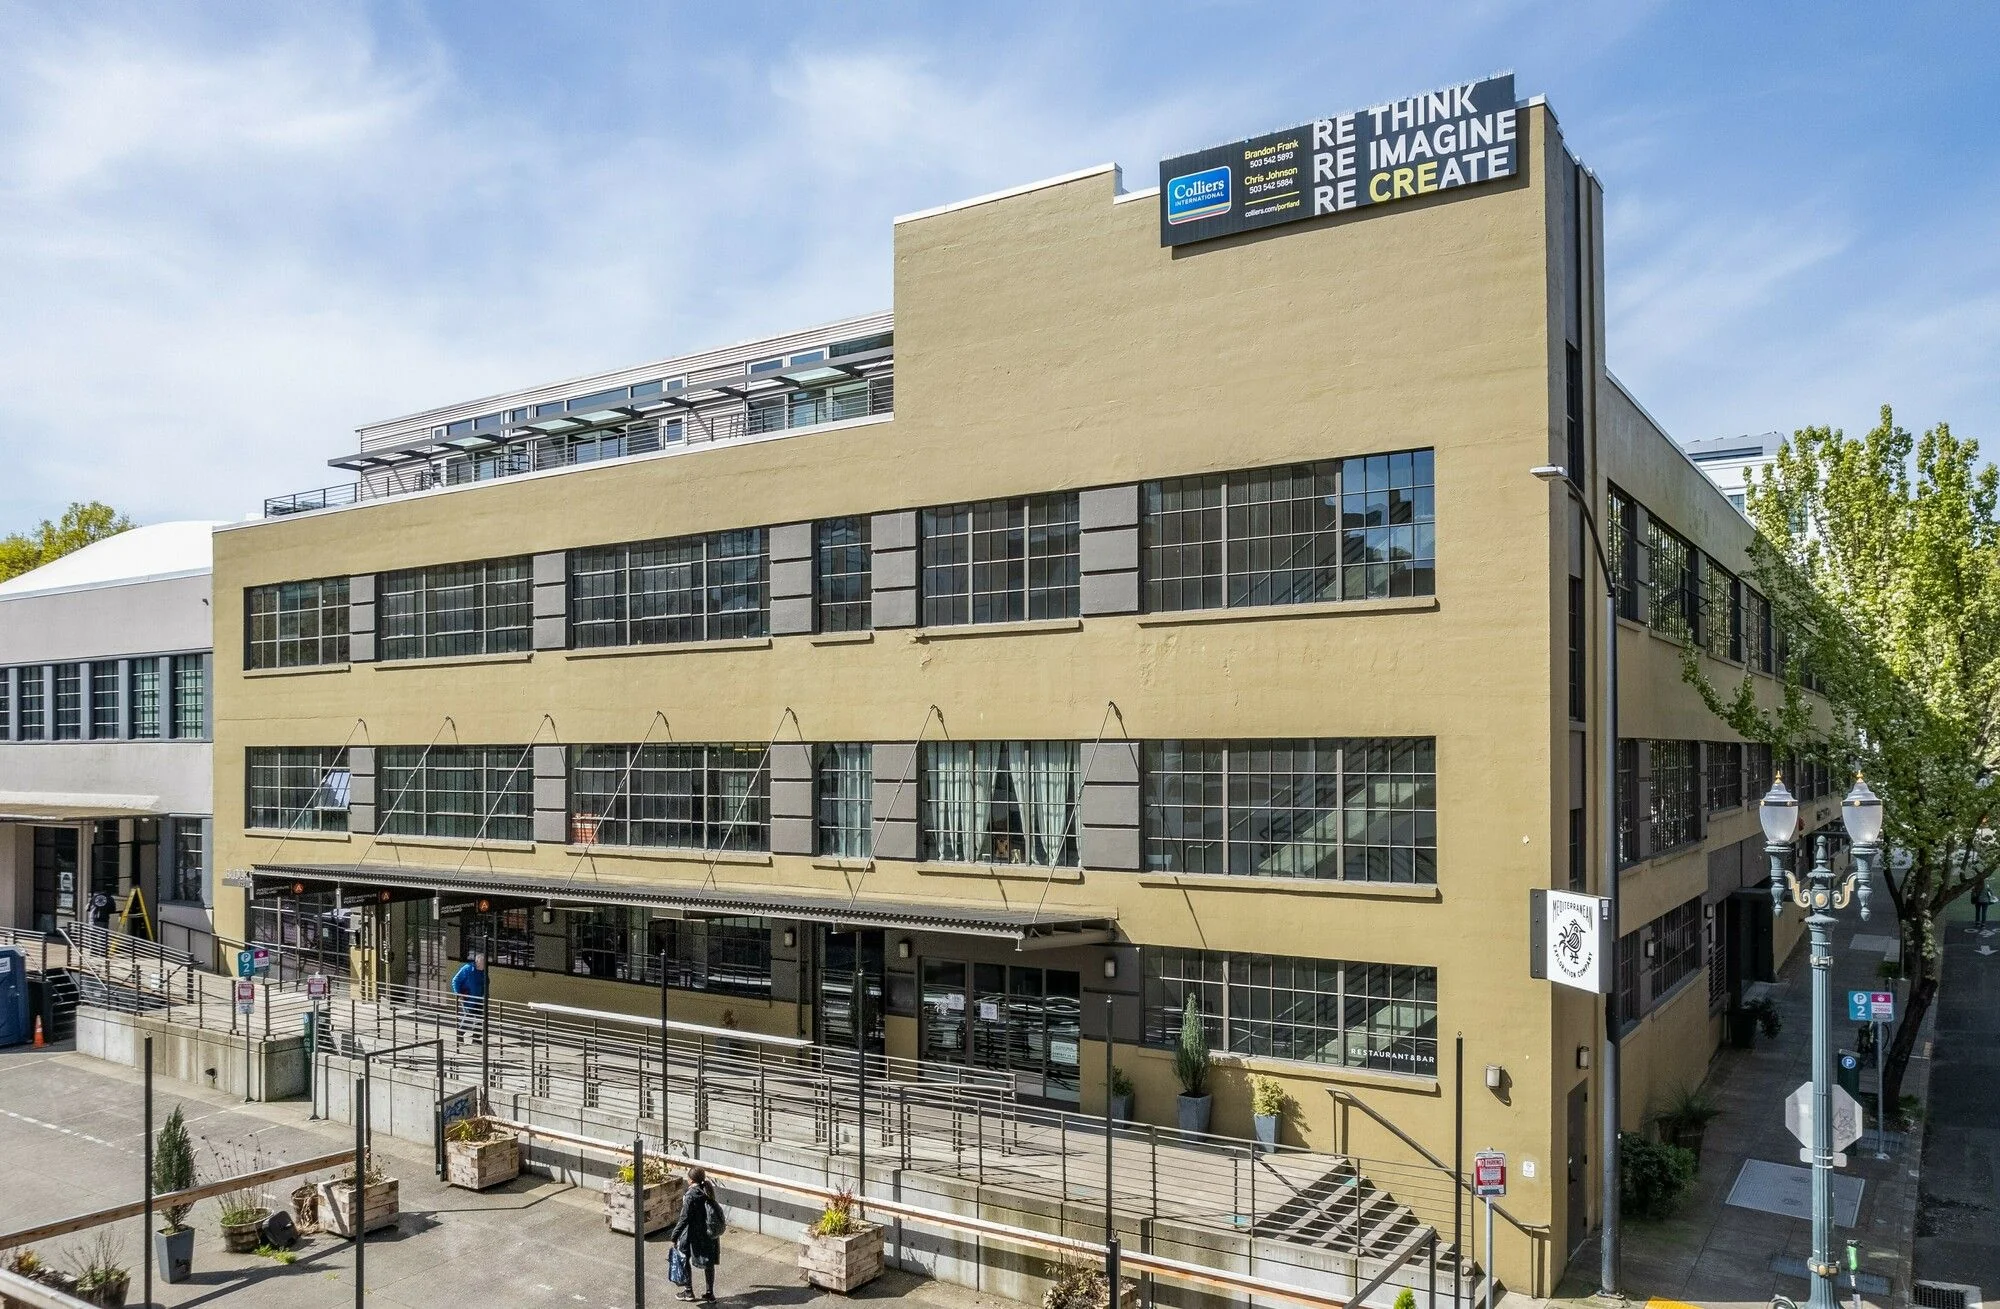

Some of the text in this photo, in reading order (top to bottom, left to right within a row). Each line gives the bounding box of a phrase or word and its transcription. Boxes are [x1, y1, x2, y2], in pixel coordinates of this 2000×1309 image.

[1313, 83, 1478, 150] RE THINK
[1244, 139, 1299, 160] Brandon Frank
[1313, 108, 1516, 183] RE IMAGINE
[1249, 157, 1262, 168] 503
[1263, 154, 1276, 165] 542
[1244, 166, 1298, 186] Chris Johnson
[1314, 145, 1510, 215] RE CREATE
[1174, 179, 1225, 200] Colliers
[1249, 183, 1262, 194] 503
[1263, 180, 1276, 192] 542
[1174, 191, 1225, 207] INTERNATIONAL
[1552, 899, 1593, 931] MEDITERRANEAN
[243, 964, 250, 973] 2
[1553, 944, 1593, 978] EXPLORATION COMPANY
[1857, 1005, 1866, 1017] 2
